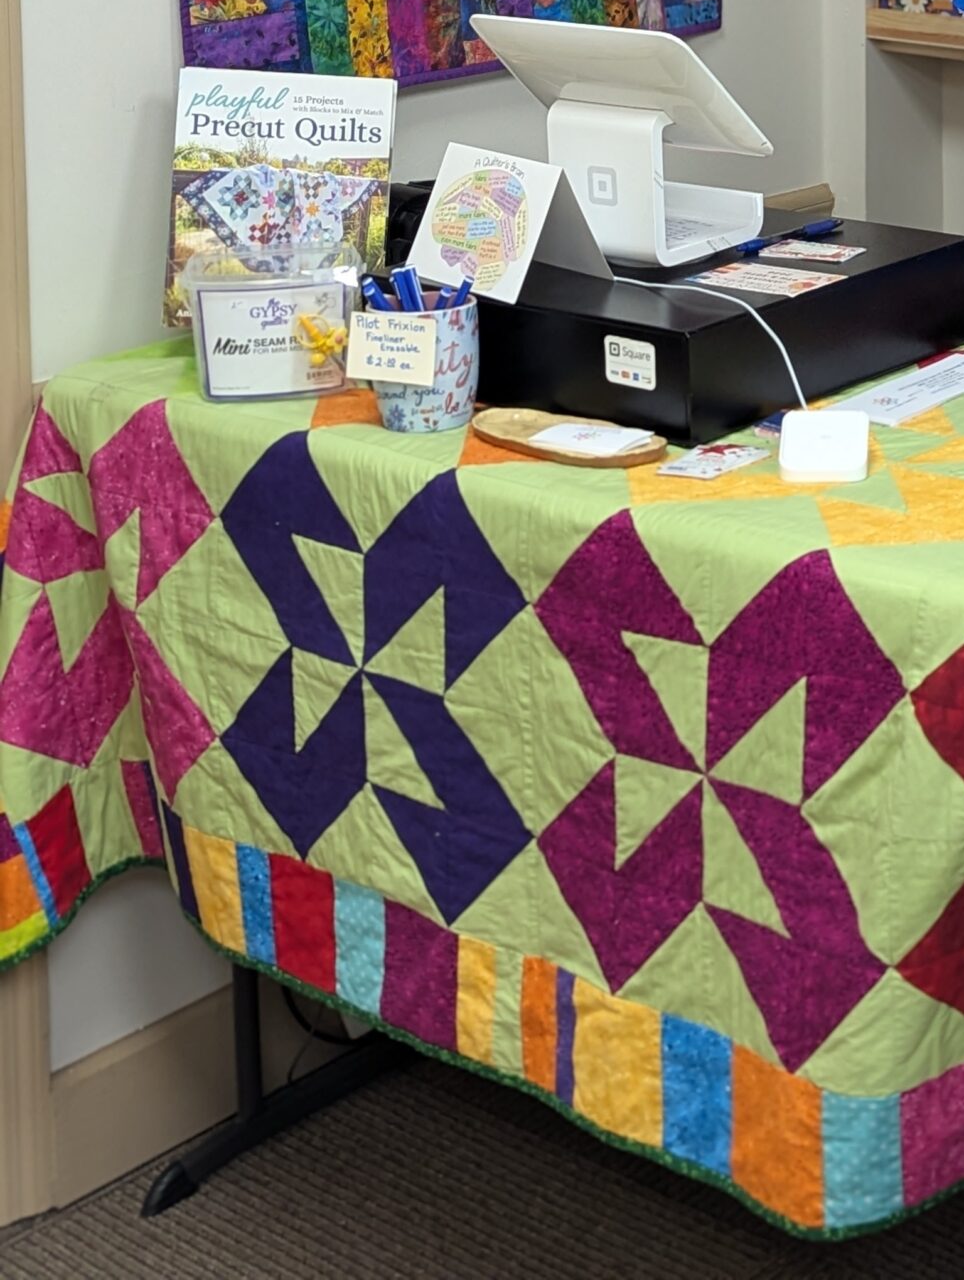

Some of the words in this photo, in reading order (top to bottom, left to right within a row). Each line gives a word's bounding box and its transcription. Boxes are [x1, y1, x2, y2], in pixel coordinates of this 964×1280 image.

[184, 84, 290, 120] playful
[293, 96, 304, 104] 15
[306, 95, 344, 106] Projects
[363, 108, 384, 116] Match
[190, 113, 285, 139] Precut
[295, 117, 382, 146] Quilts
[249, 303, 297, 320] GYPSY
[355, 315, 380, 329] Pilot
[388, 319, 425, 332] Frixion
[366, 332, 405, 343] Fineliner
[212, 337, 252, 355] Mini
[253, 337, 286, 347] SEAM
[380, 342, 420, 353] Erasable
[622, 346, 651, 361] Square
